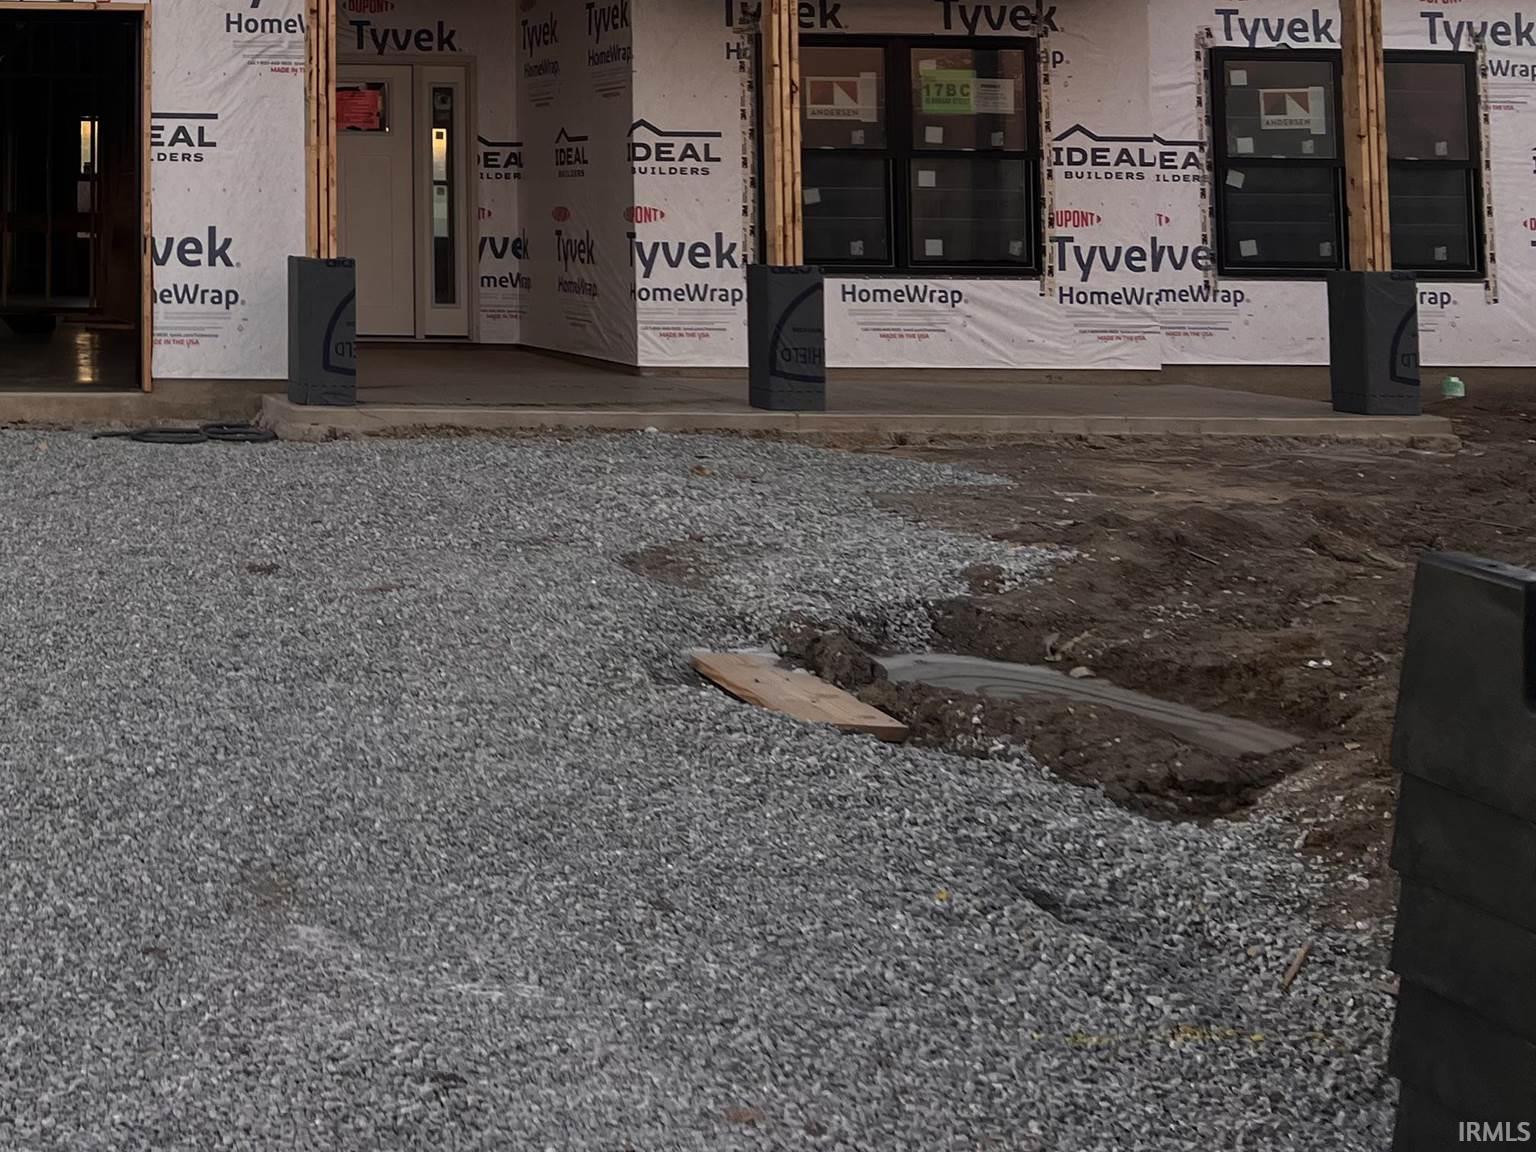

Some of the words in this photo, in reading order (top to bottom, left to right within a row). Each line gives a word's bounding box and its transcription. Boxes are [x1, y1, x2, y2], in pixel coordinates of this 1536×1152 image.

[348, 0, 390, 14] DUPONT
[349, 20, 457, 55] Tyvek
[521, 12, 558, 58] Tyvek
[1215, 9, 1336, 47] Tyvek
[151, 152, 204, 162] DERS
[555, 146, 588, 166] IDEAL
[627, 143, 721, 162] IDEAL
[1064, 171, 1145, 181] BUILDERS
[626, 232, 738, 278] Tyvek
[841, 284, 963, 307] HomeWrap
[1419, 291, 1451, 308] rap
